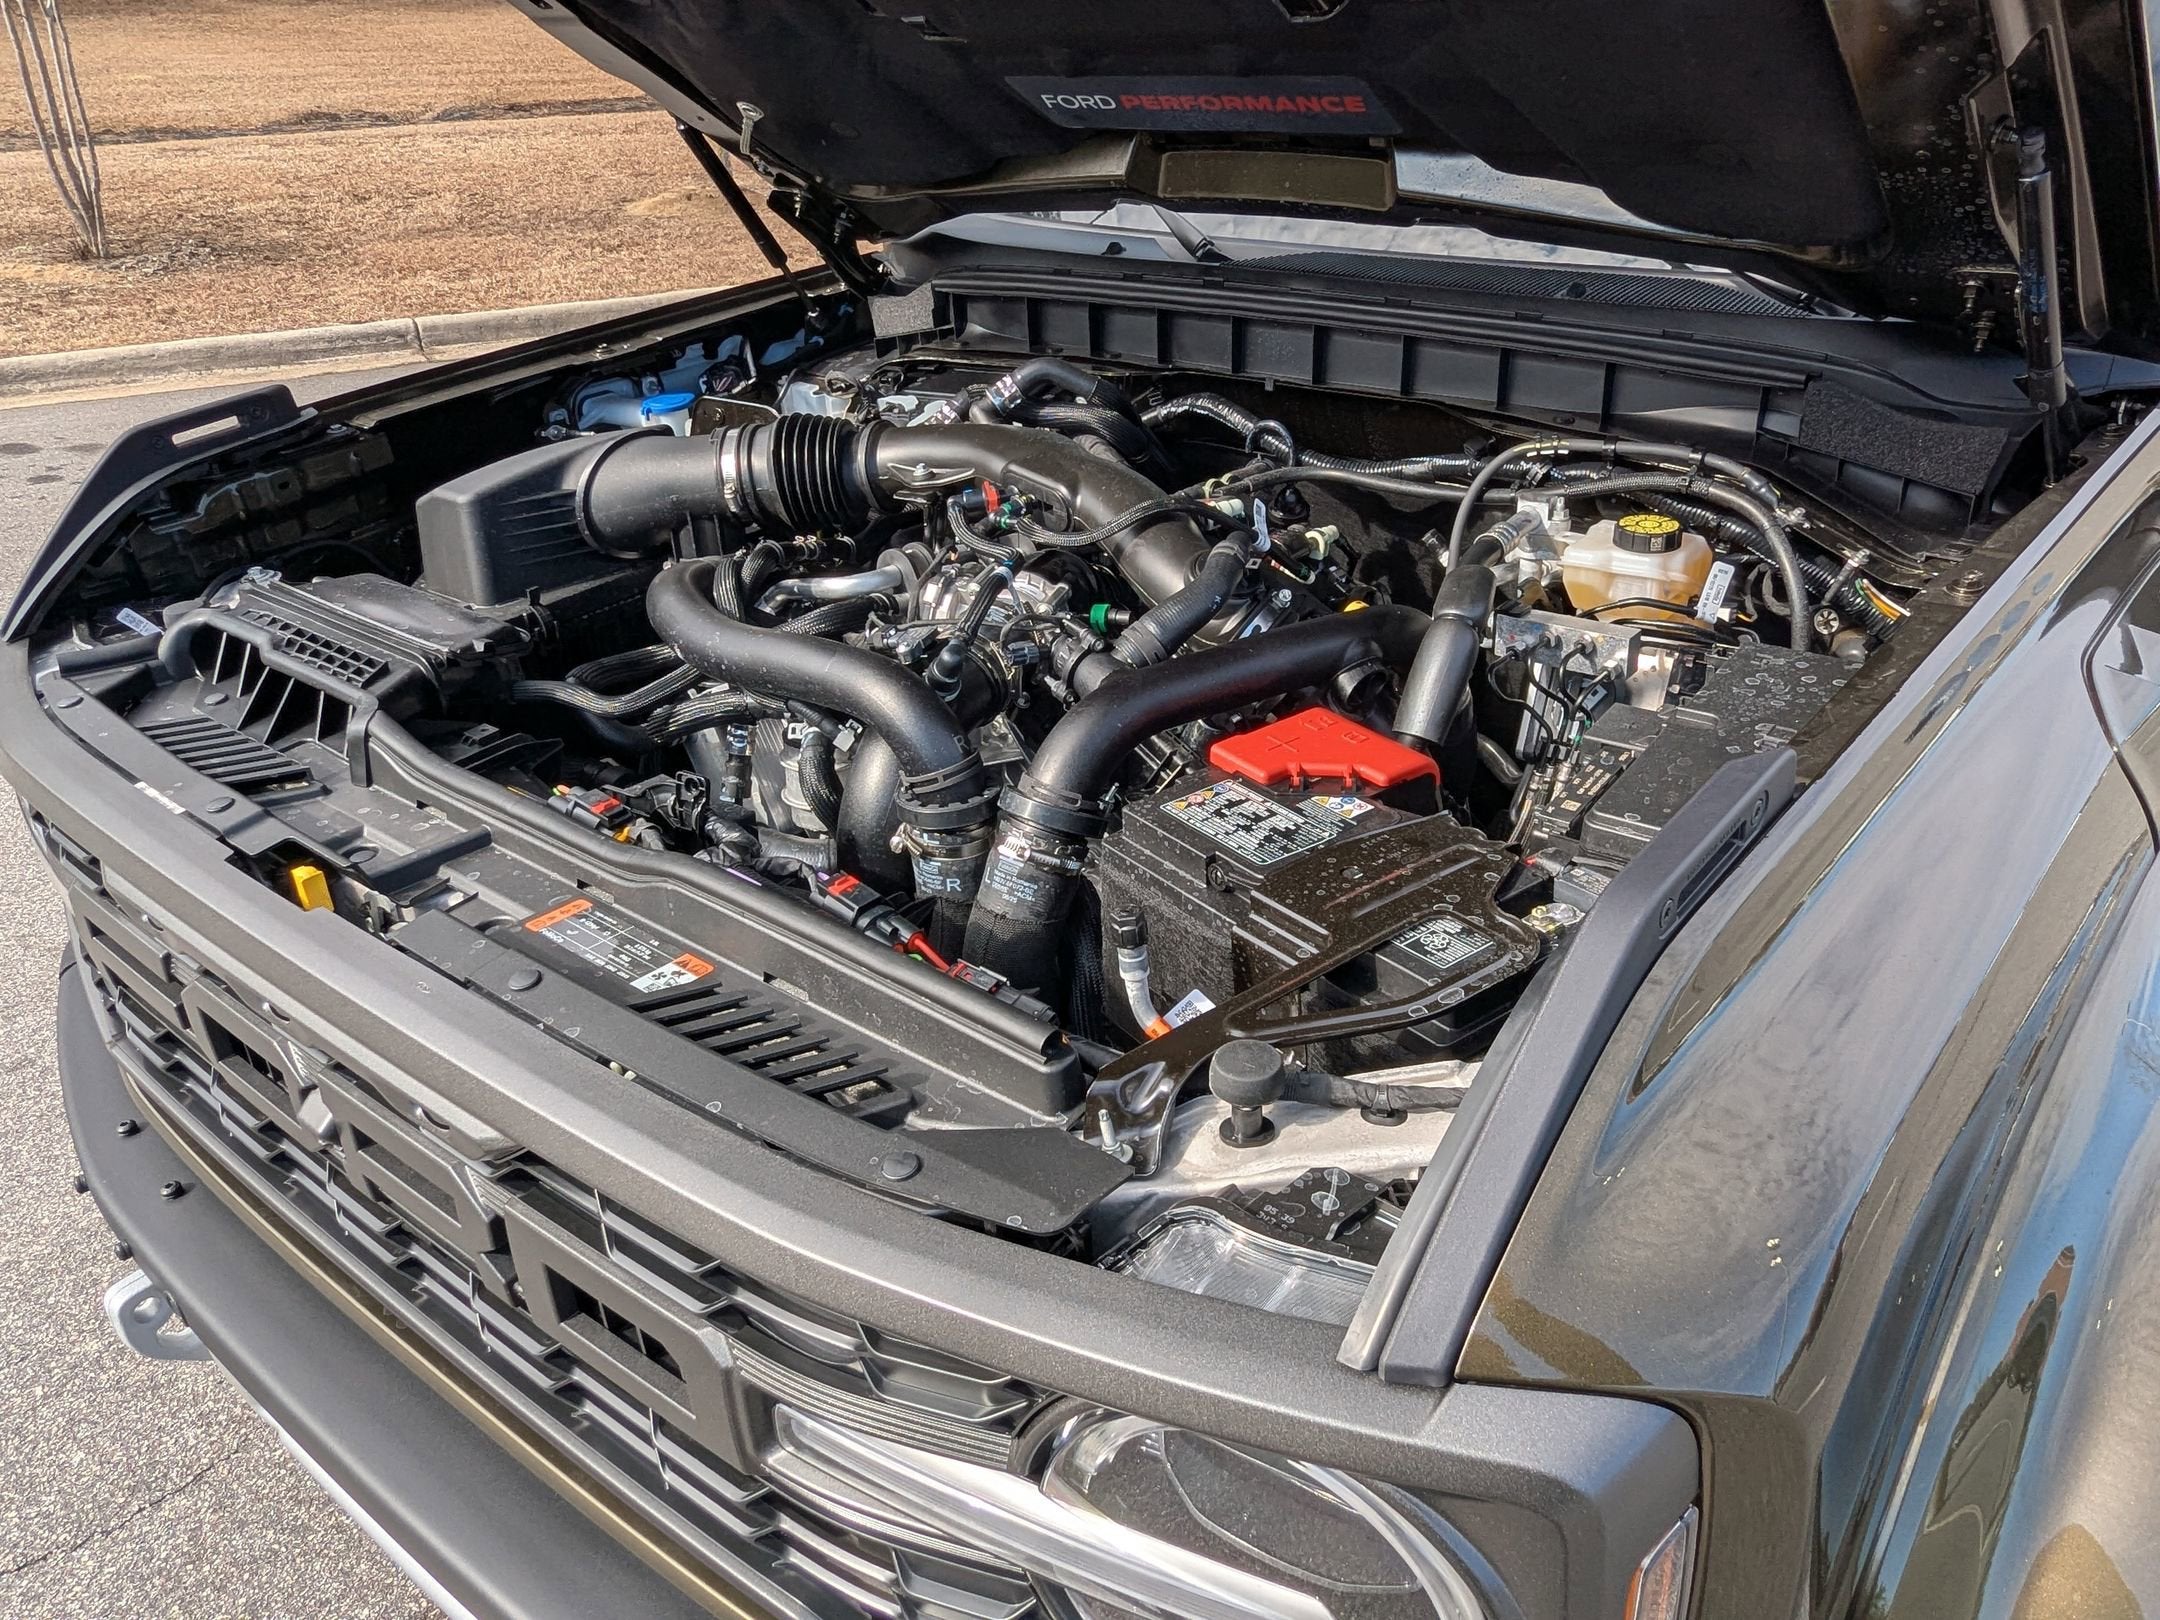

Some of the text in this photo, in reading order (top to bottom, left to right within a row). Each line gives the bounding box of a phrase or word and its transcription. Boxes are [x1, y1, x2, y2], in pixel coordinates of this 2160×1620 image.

[1041, 93, 1367, 113] FORD PERFORMANCE
[946, 878, 962, 892] R
